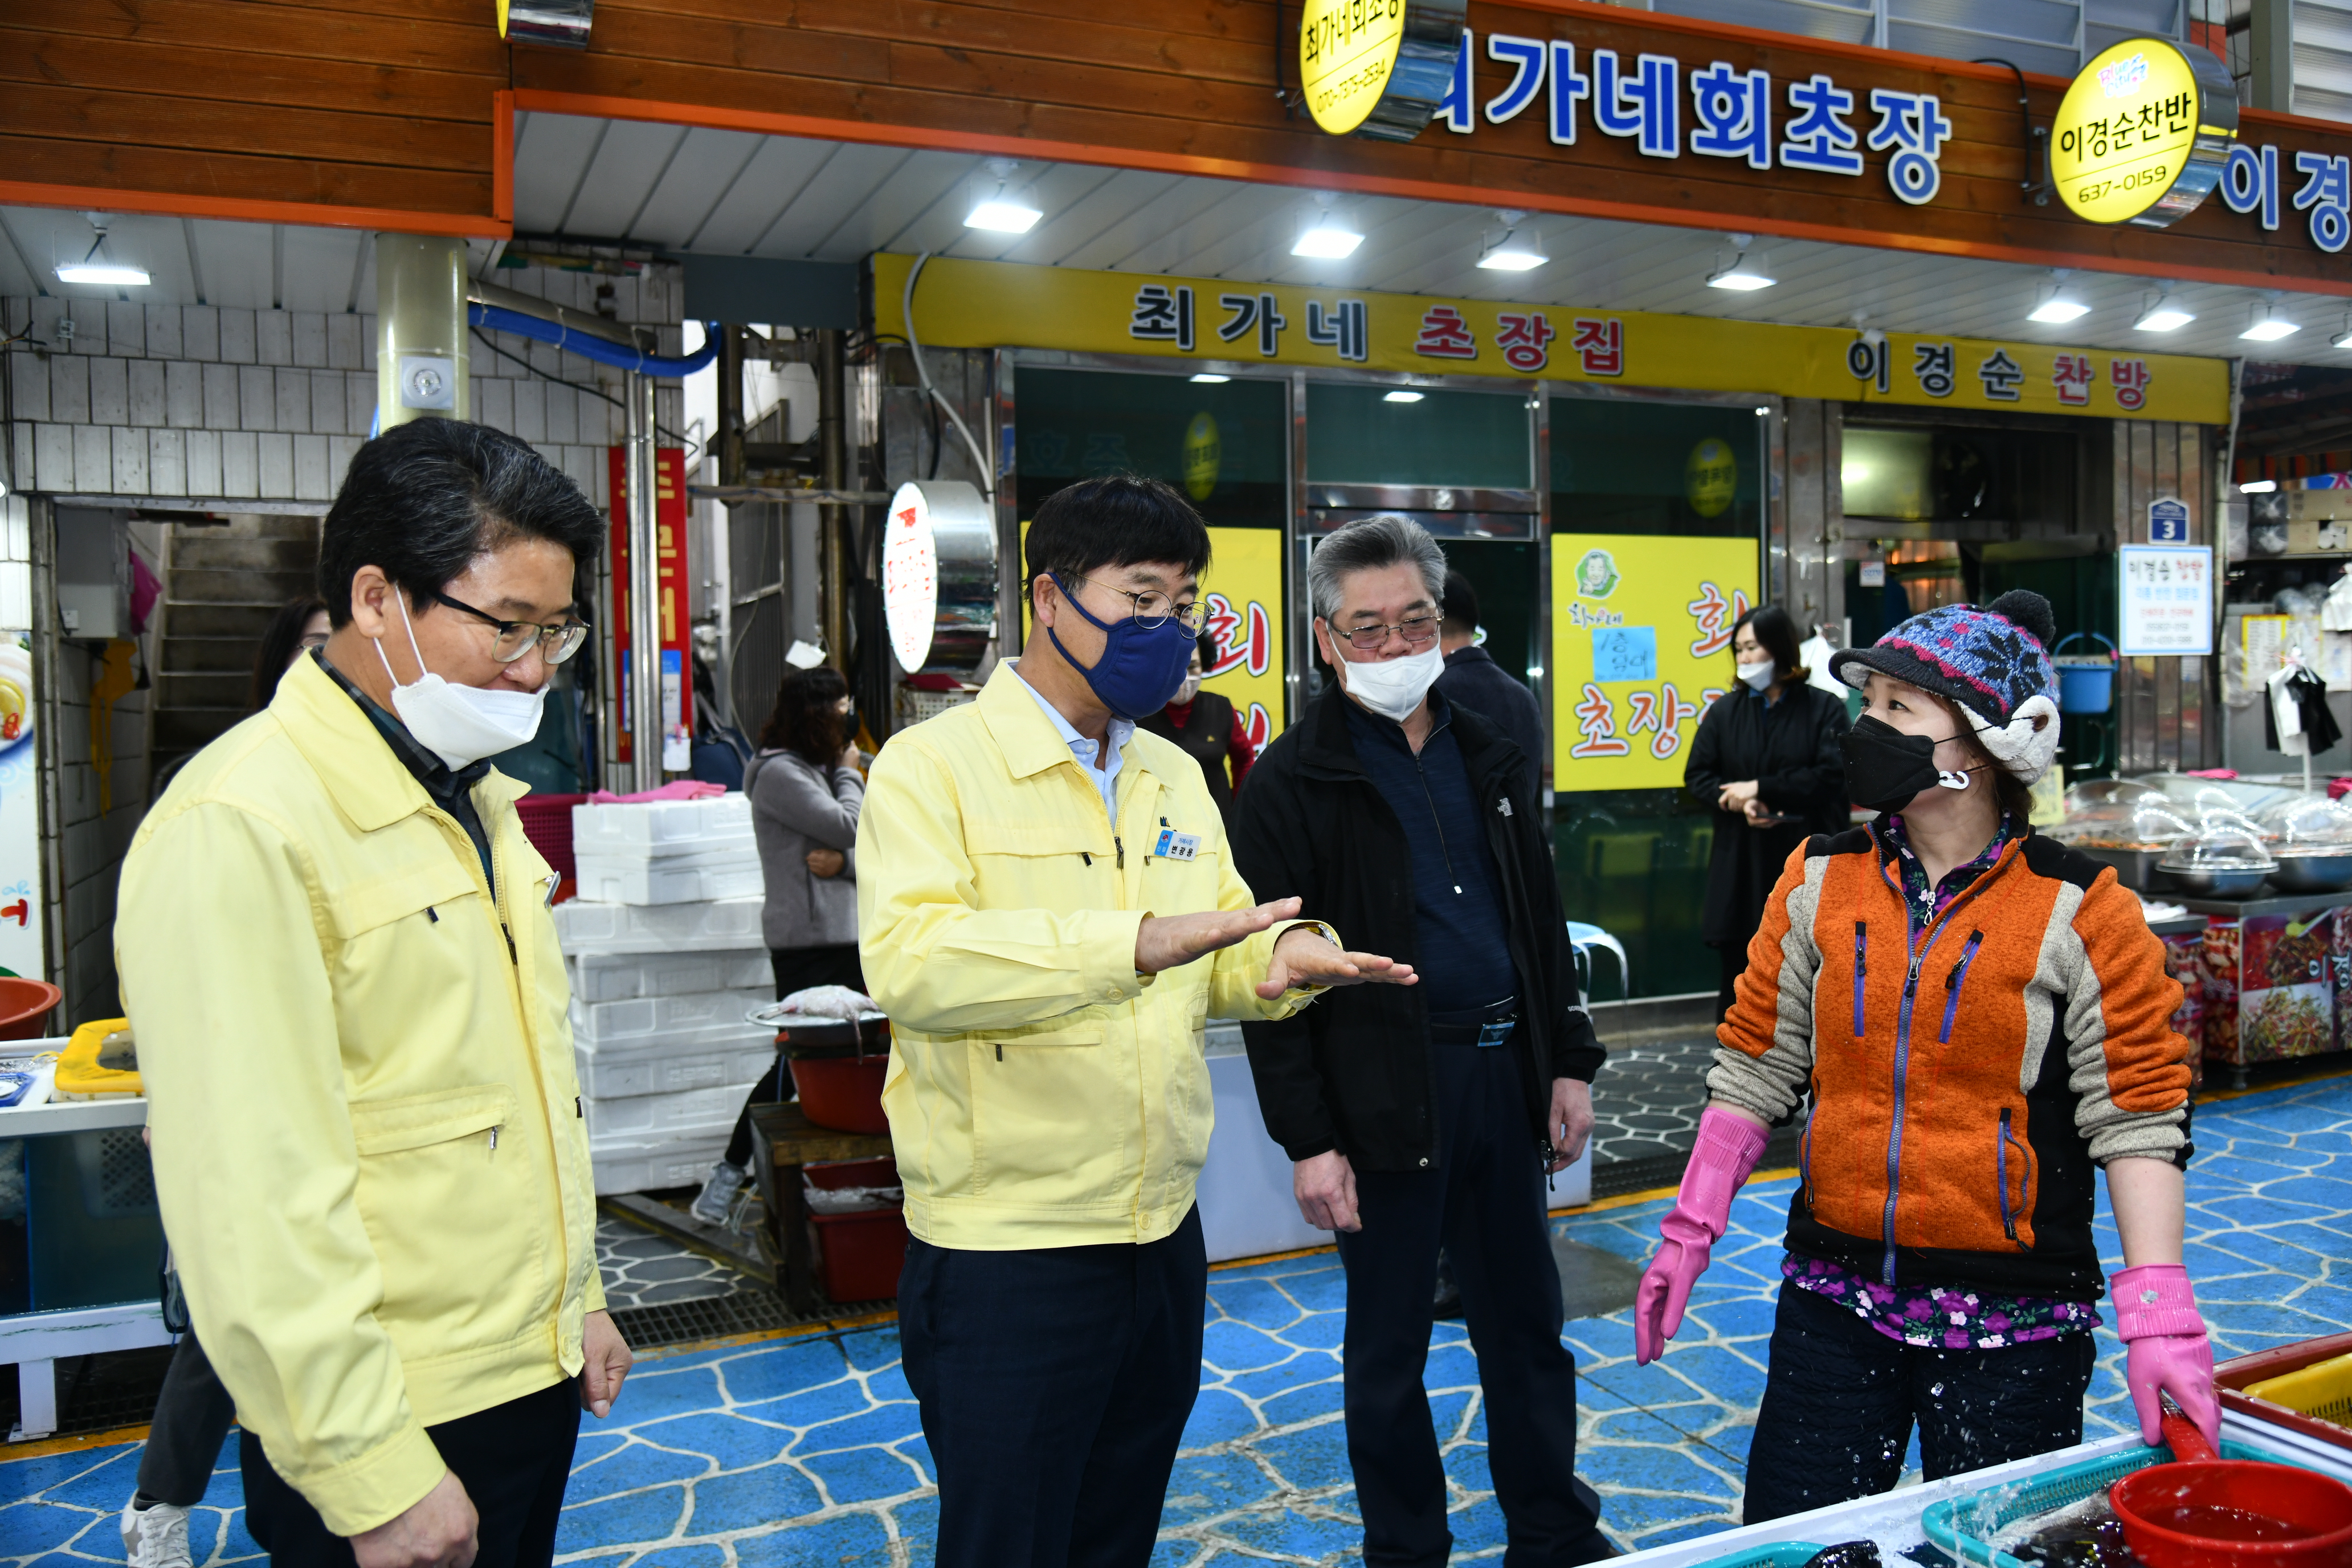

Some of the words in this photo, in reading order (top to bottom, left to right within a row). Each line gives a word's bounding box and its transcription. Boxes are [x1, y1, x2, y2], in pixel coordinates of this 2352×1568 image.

[2061, 92, 2192, 162] 이경순찬반
[2079, 165, 2166, 203] 637-0159
[1130, 284, 1367, 361] 최가네
[1415, 305, 1623, 377] 초장집
[2162, 520, 2176, 539] 3
[1571, 683, 1725, 760] 초장
